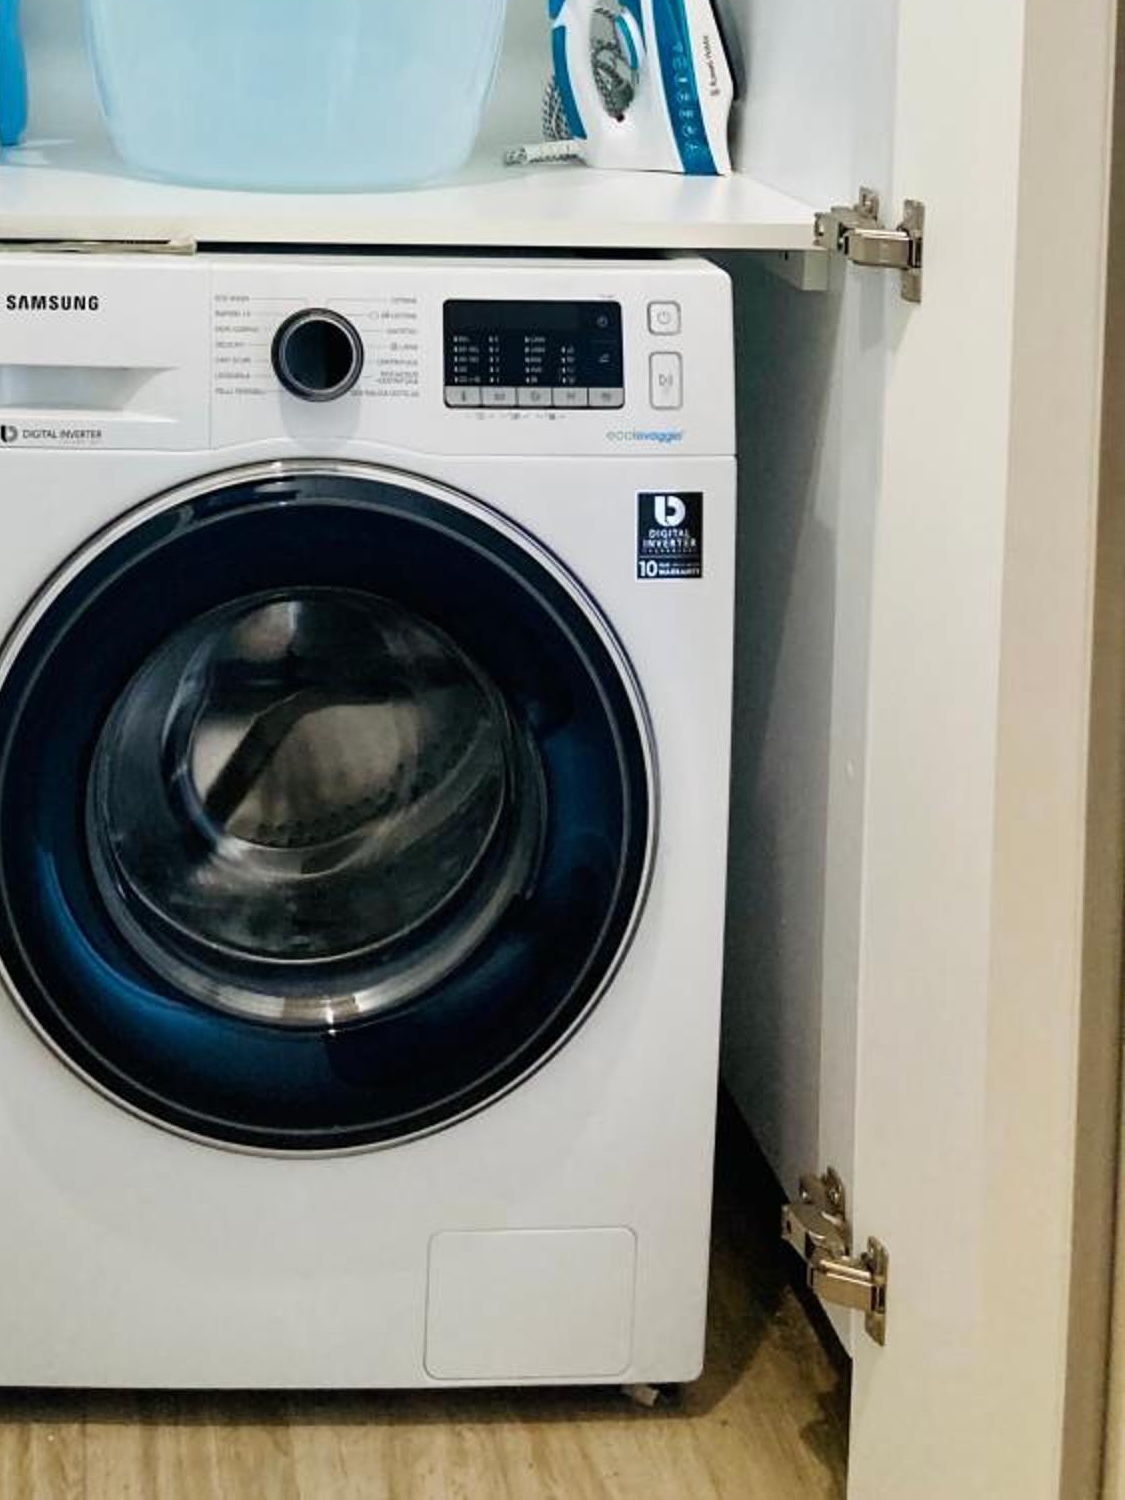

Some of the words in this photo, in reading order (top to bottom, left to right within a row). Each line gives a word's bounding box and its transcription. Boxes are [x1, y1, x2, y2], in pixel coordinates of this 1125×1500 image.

[6, 295, 99, 311] SAMSUNG
[22, 429, 57, 439] DIGITAL
[59, 429, 102, 439] INVERTER
[648, 528, 690, 538] DIGITAL
[642, 538, 696, 548] INVERTER
[638, 560, 658, 577] 10
